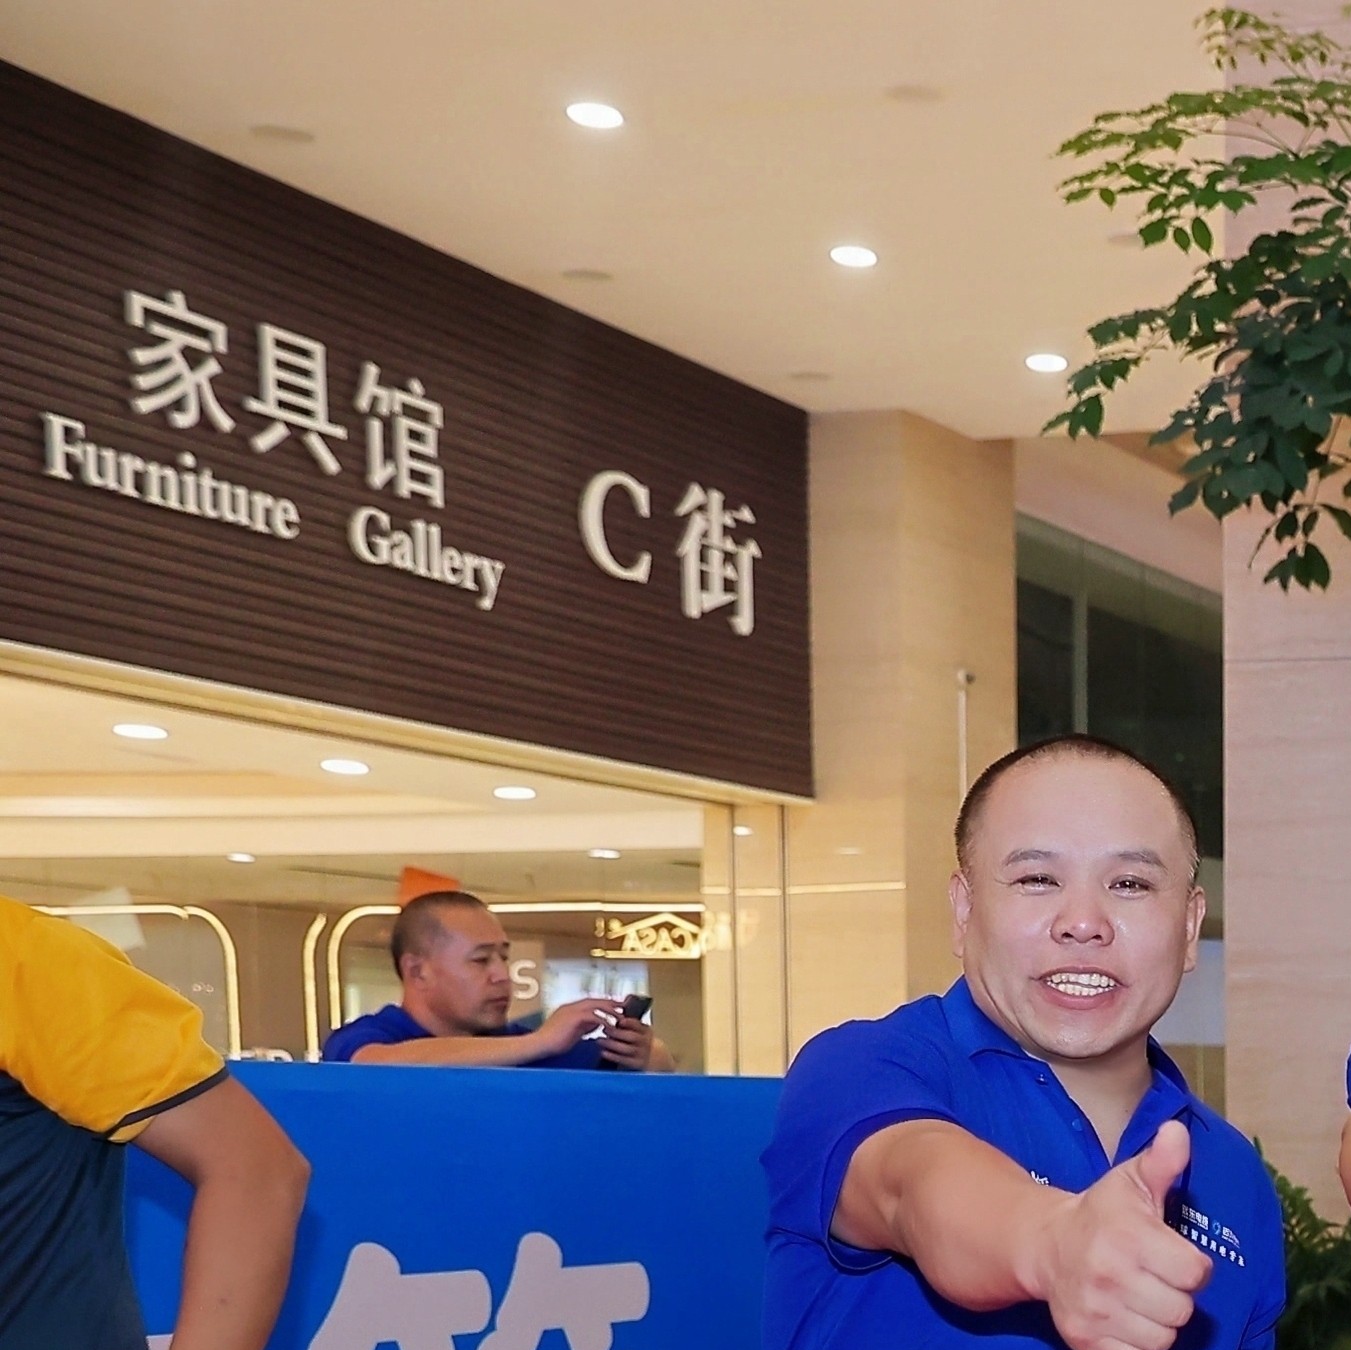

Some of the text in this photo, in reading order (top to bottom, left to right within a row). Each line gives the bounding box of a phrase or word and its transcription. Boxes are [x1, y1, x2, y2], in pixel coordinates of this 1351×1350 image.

[123, 288, 447, 509] 家具馆
[42, 412, 506, 610] Furniture Gallery
[578, 470, 762, 637] C 街
